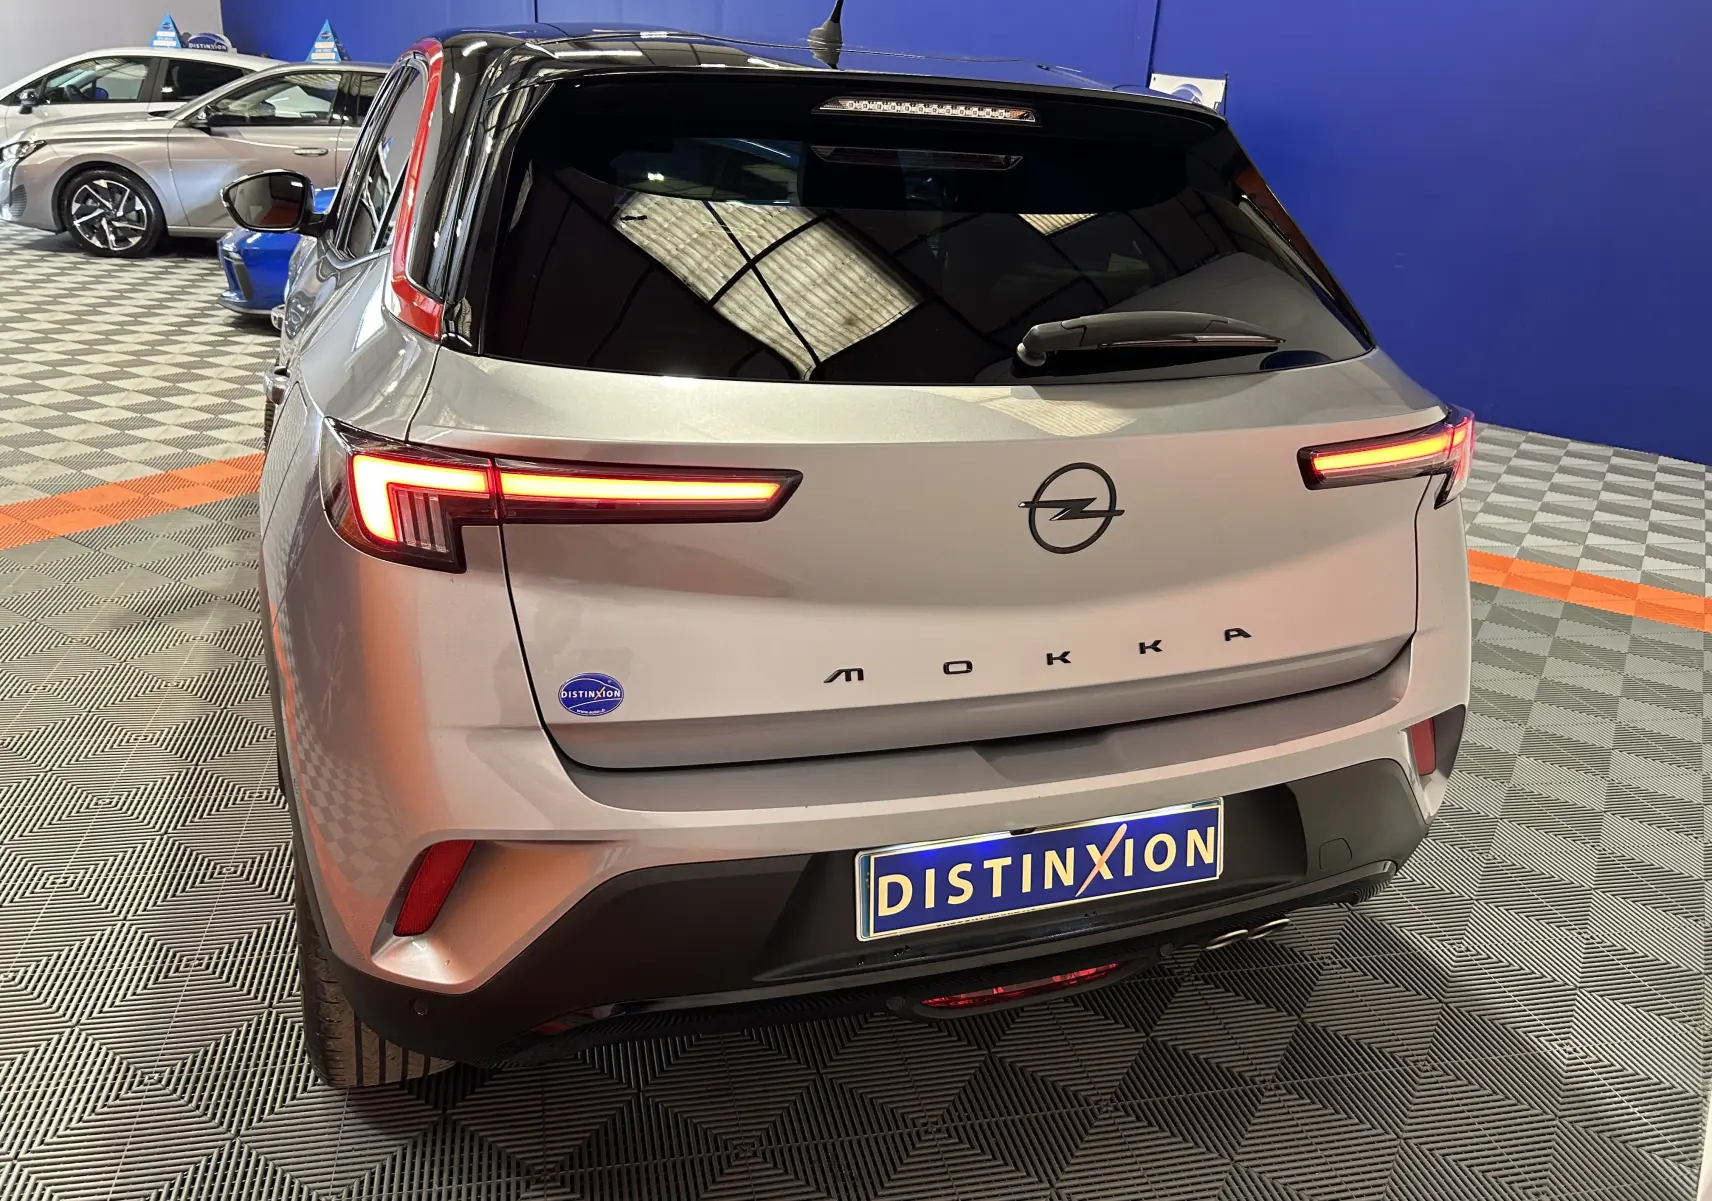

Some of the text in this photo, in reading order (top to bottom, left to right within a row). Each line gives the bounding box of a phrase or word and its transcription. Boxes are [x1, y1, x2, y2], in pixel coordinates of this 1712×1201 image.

[823, 627, 1252, 684] MOKKA
[561, 686, 621, 700] DISTINXION
[877, 823, 1215, 917] DISTINXION
